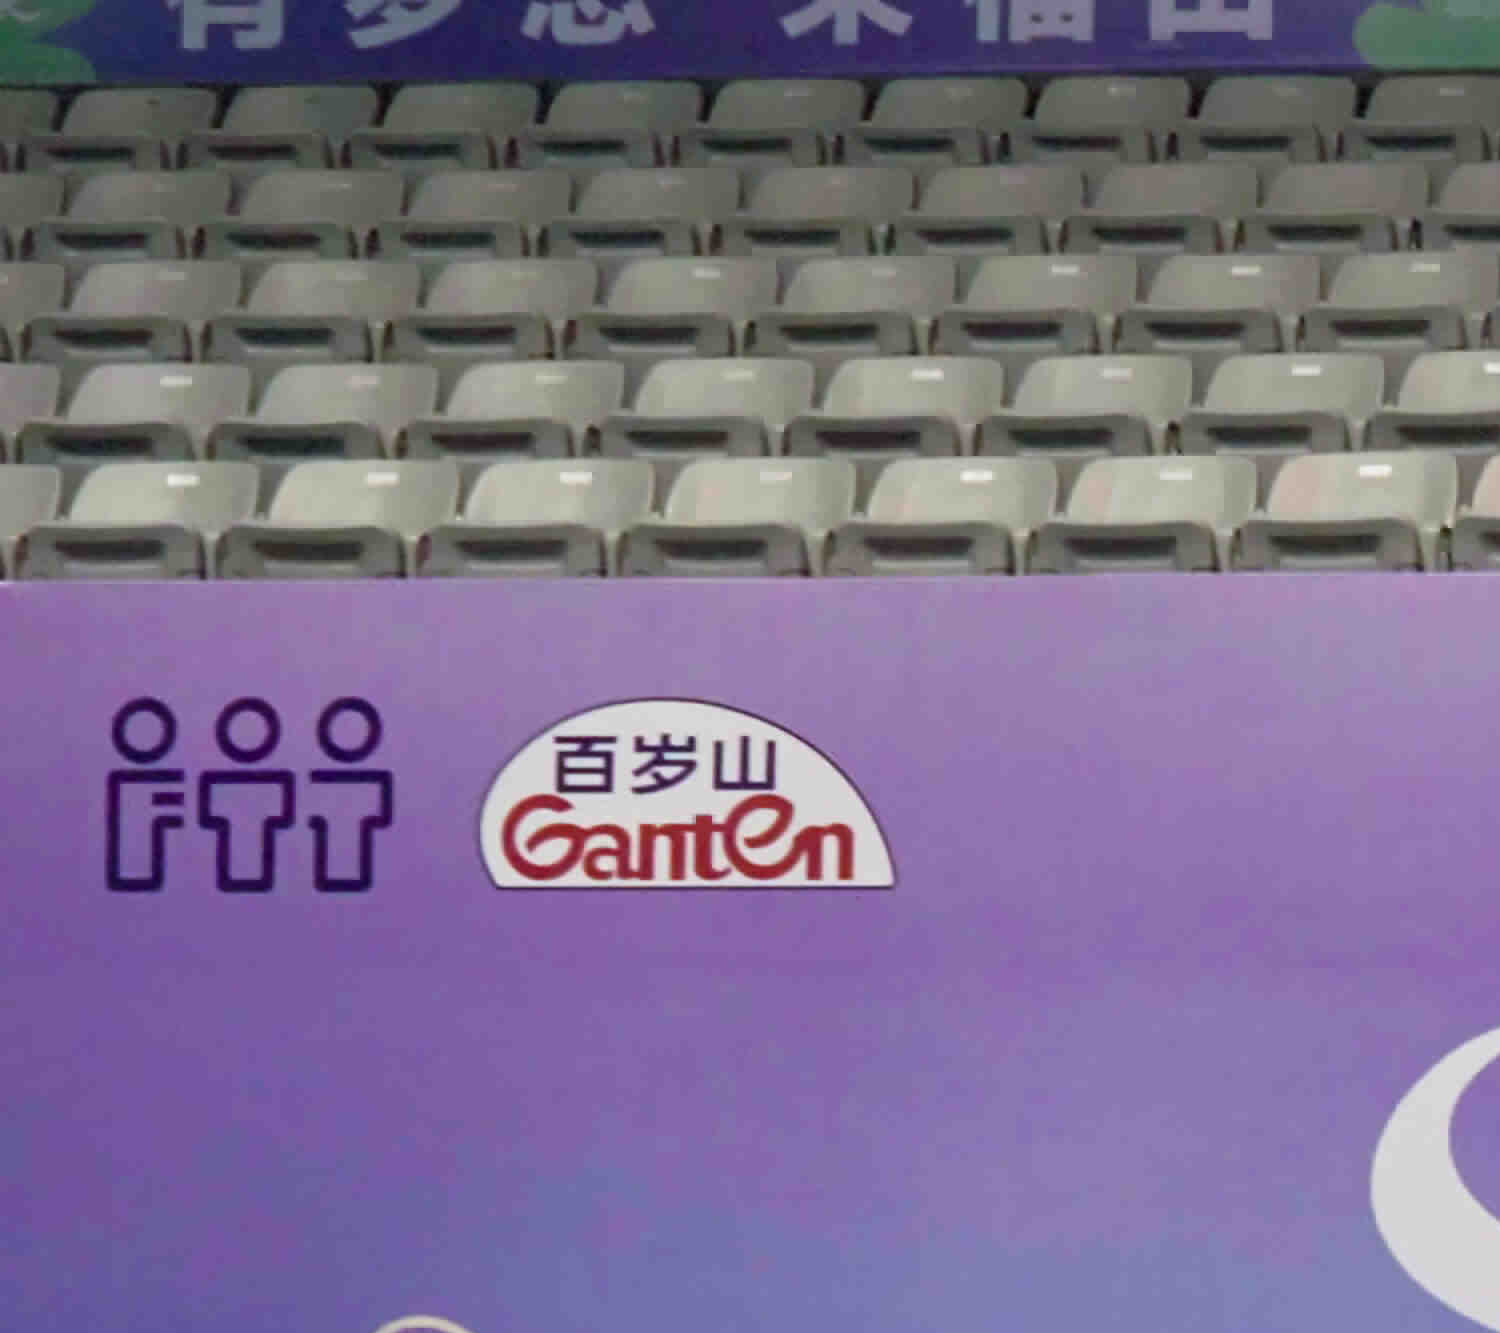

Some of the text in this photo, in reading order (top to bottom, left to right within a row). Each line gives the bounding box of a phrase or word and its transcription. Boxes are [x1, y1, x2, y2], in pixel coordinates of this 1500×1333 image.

[554, 733, 776, 795] 百岁山
[500, 794, 856, 881] Ganten
